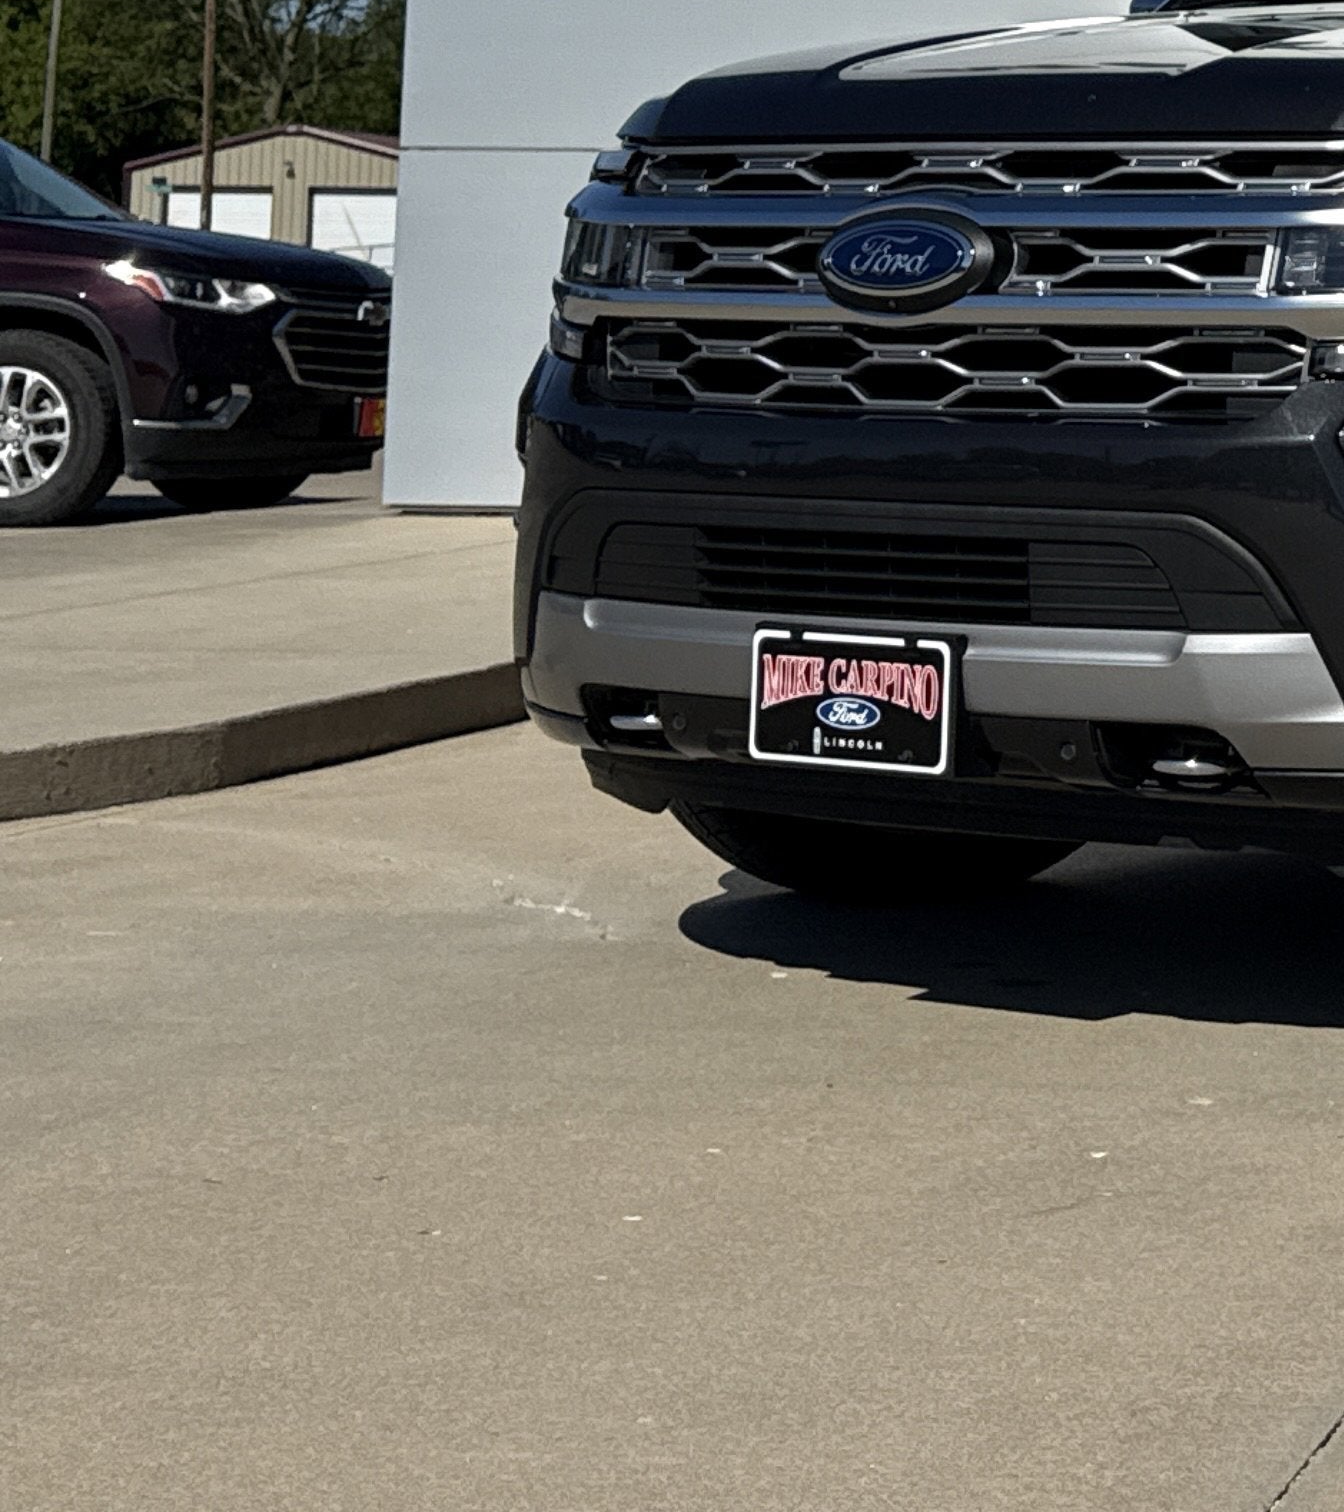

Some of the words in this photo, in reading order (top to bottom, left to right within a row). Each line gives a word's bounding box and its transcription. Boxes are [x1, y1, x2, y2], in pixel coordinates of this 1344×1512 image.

[850, 235, 936, 276] Ford
[761, 653, 824, 710] MIKE
[828, 658, 939, 721] CARPINO
[828, 701, 869, 725] Ford
[823, 736, 883, 750] LINCOLN
